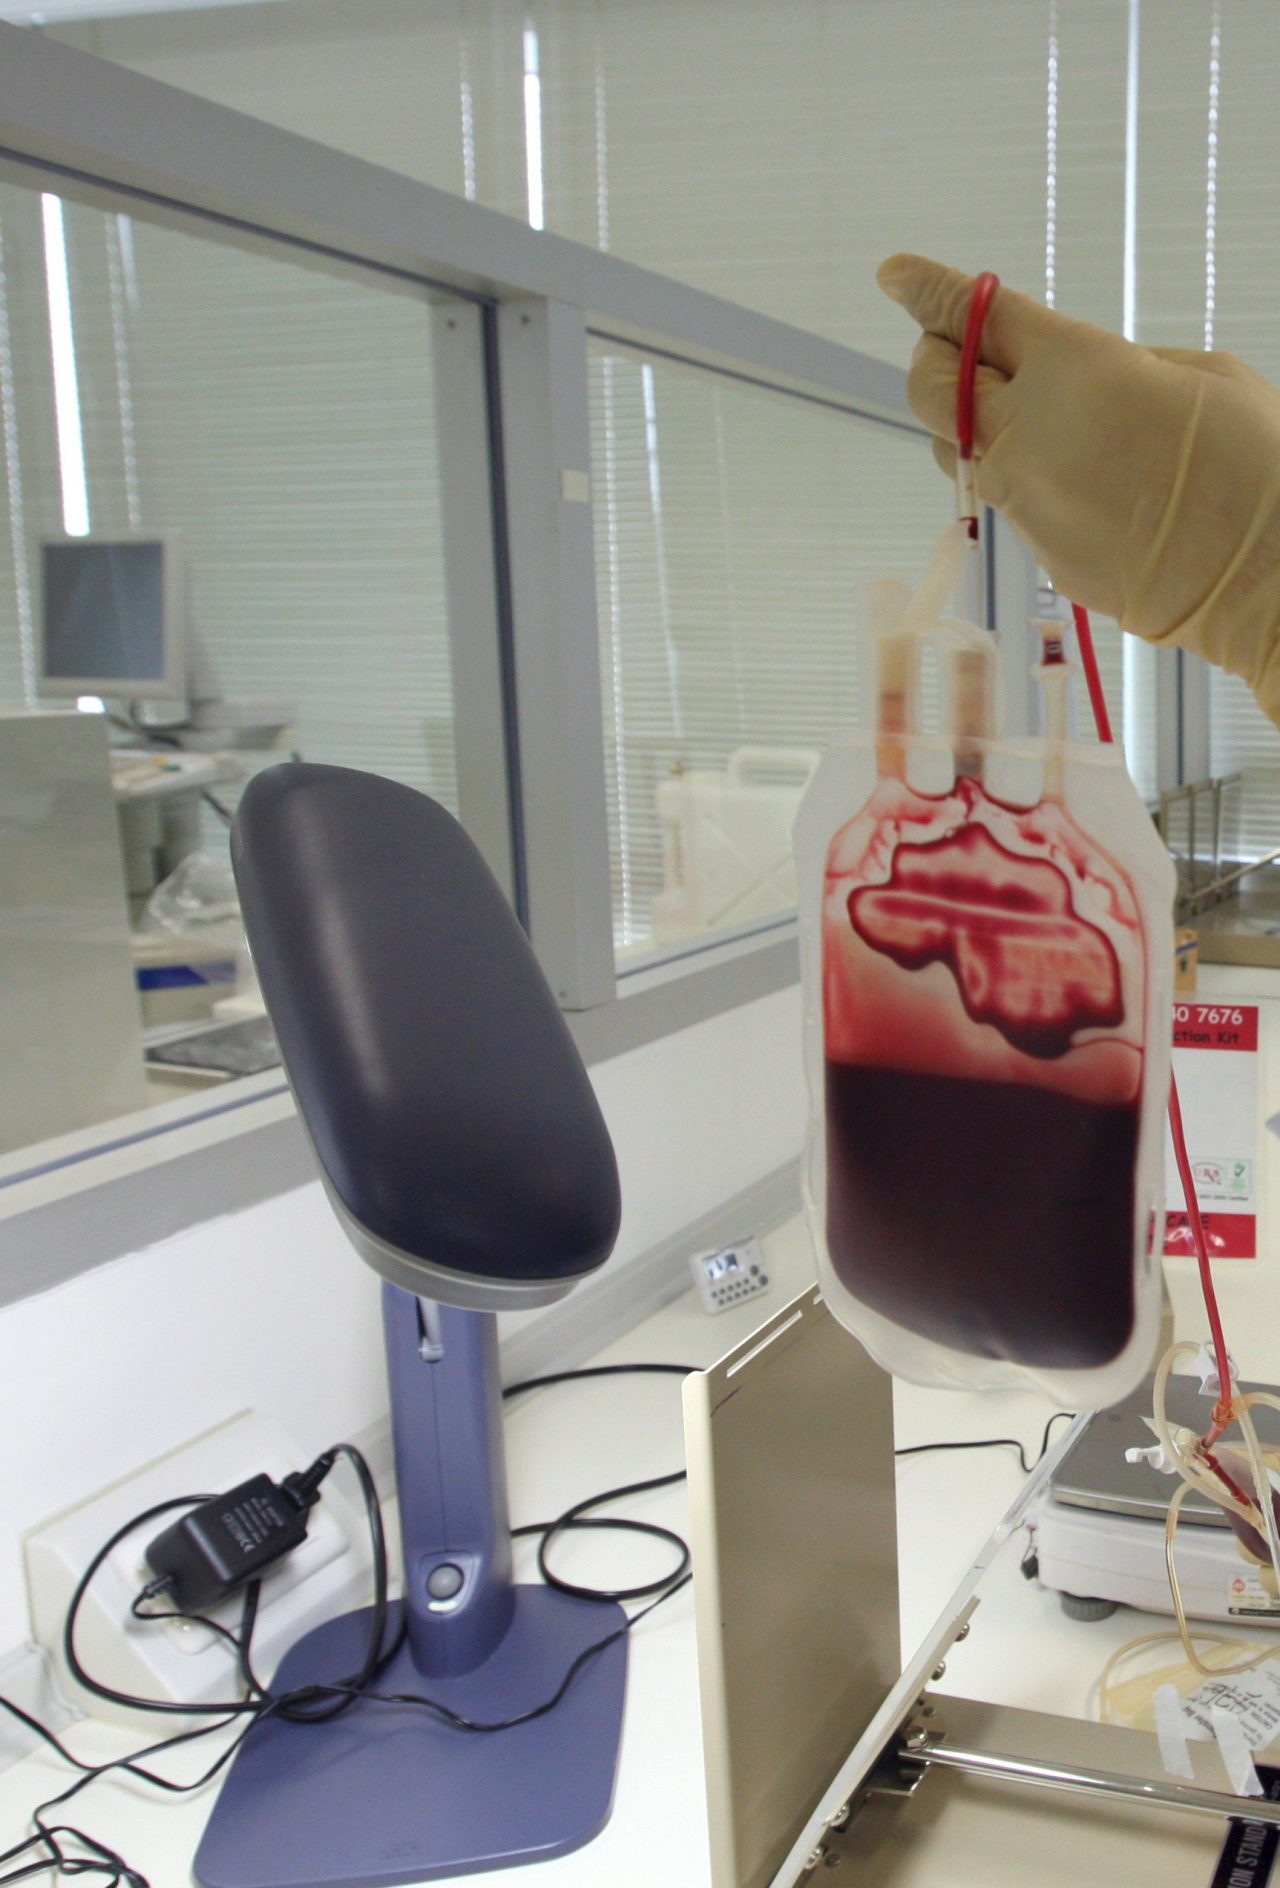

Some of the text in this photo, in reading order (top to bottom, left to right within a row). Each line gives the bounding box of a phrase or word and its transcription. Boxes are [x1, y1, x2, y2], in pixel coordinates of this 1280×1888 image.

[1196, 1007, 1243, 1025] 7676
[1217, 1031, 1240, 1044] Kit
[1166, 1214, 1209, 1230] CAE
[1236, 1826, 1268, 1867] STAND
